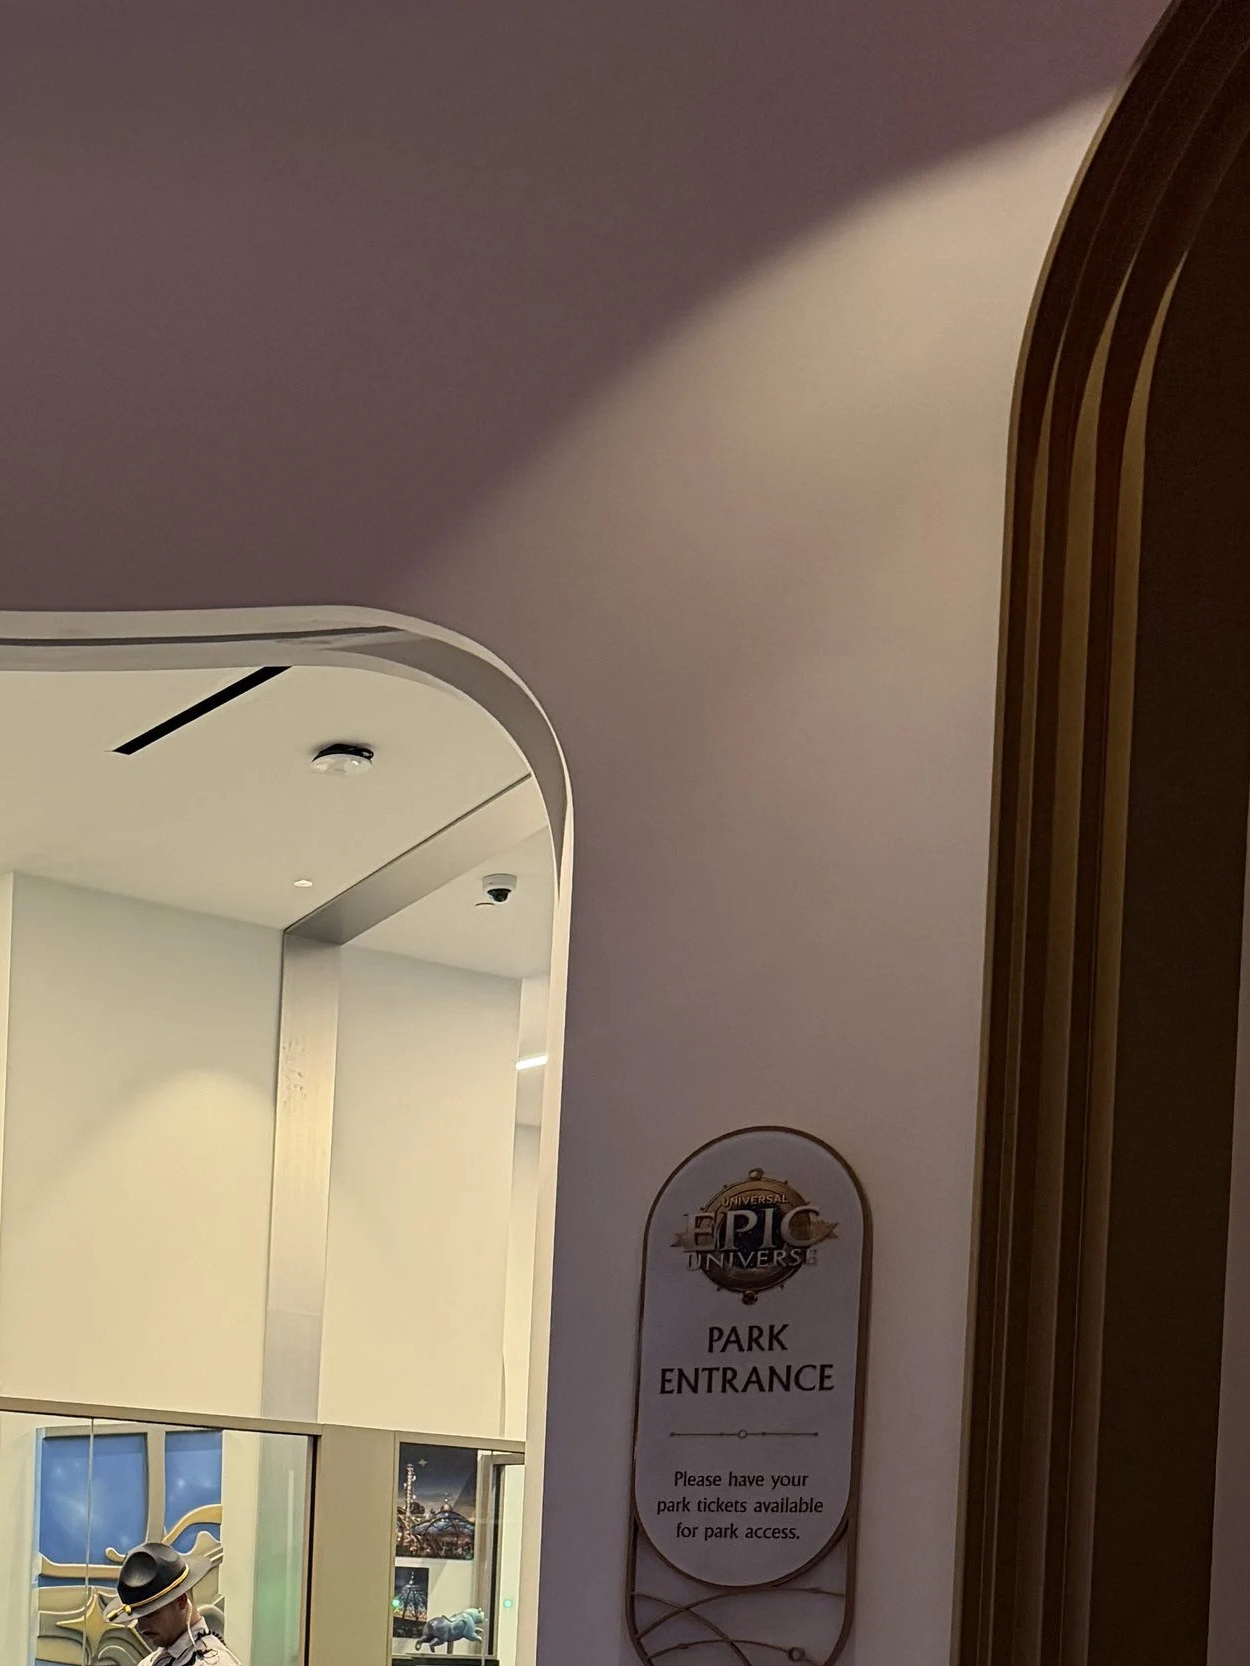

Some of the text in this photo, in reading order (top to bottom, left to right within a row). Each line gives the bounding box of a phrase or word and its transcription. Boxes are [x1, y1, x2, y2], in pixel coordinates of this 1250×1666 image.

[721, 1194, 788, 1207] UNIVERSAL
[683, 1205, 820, 1252] EPIC
[685, 1249, 818, 1271] UNIVERSE
[708, 1324, 789, 1353] PARK
[660, 1364, 835, 1394] ENTRANCE
[674, 1471, 809, 1490] Please have your
[657, 1497, 824, 1515] park tickets available
[676, 1522, 800, 1541] for park access.
